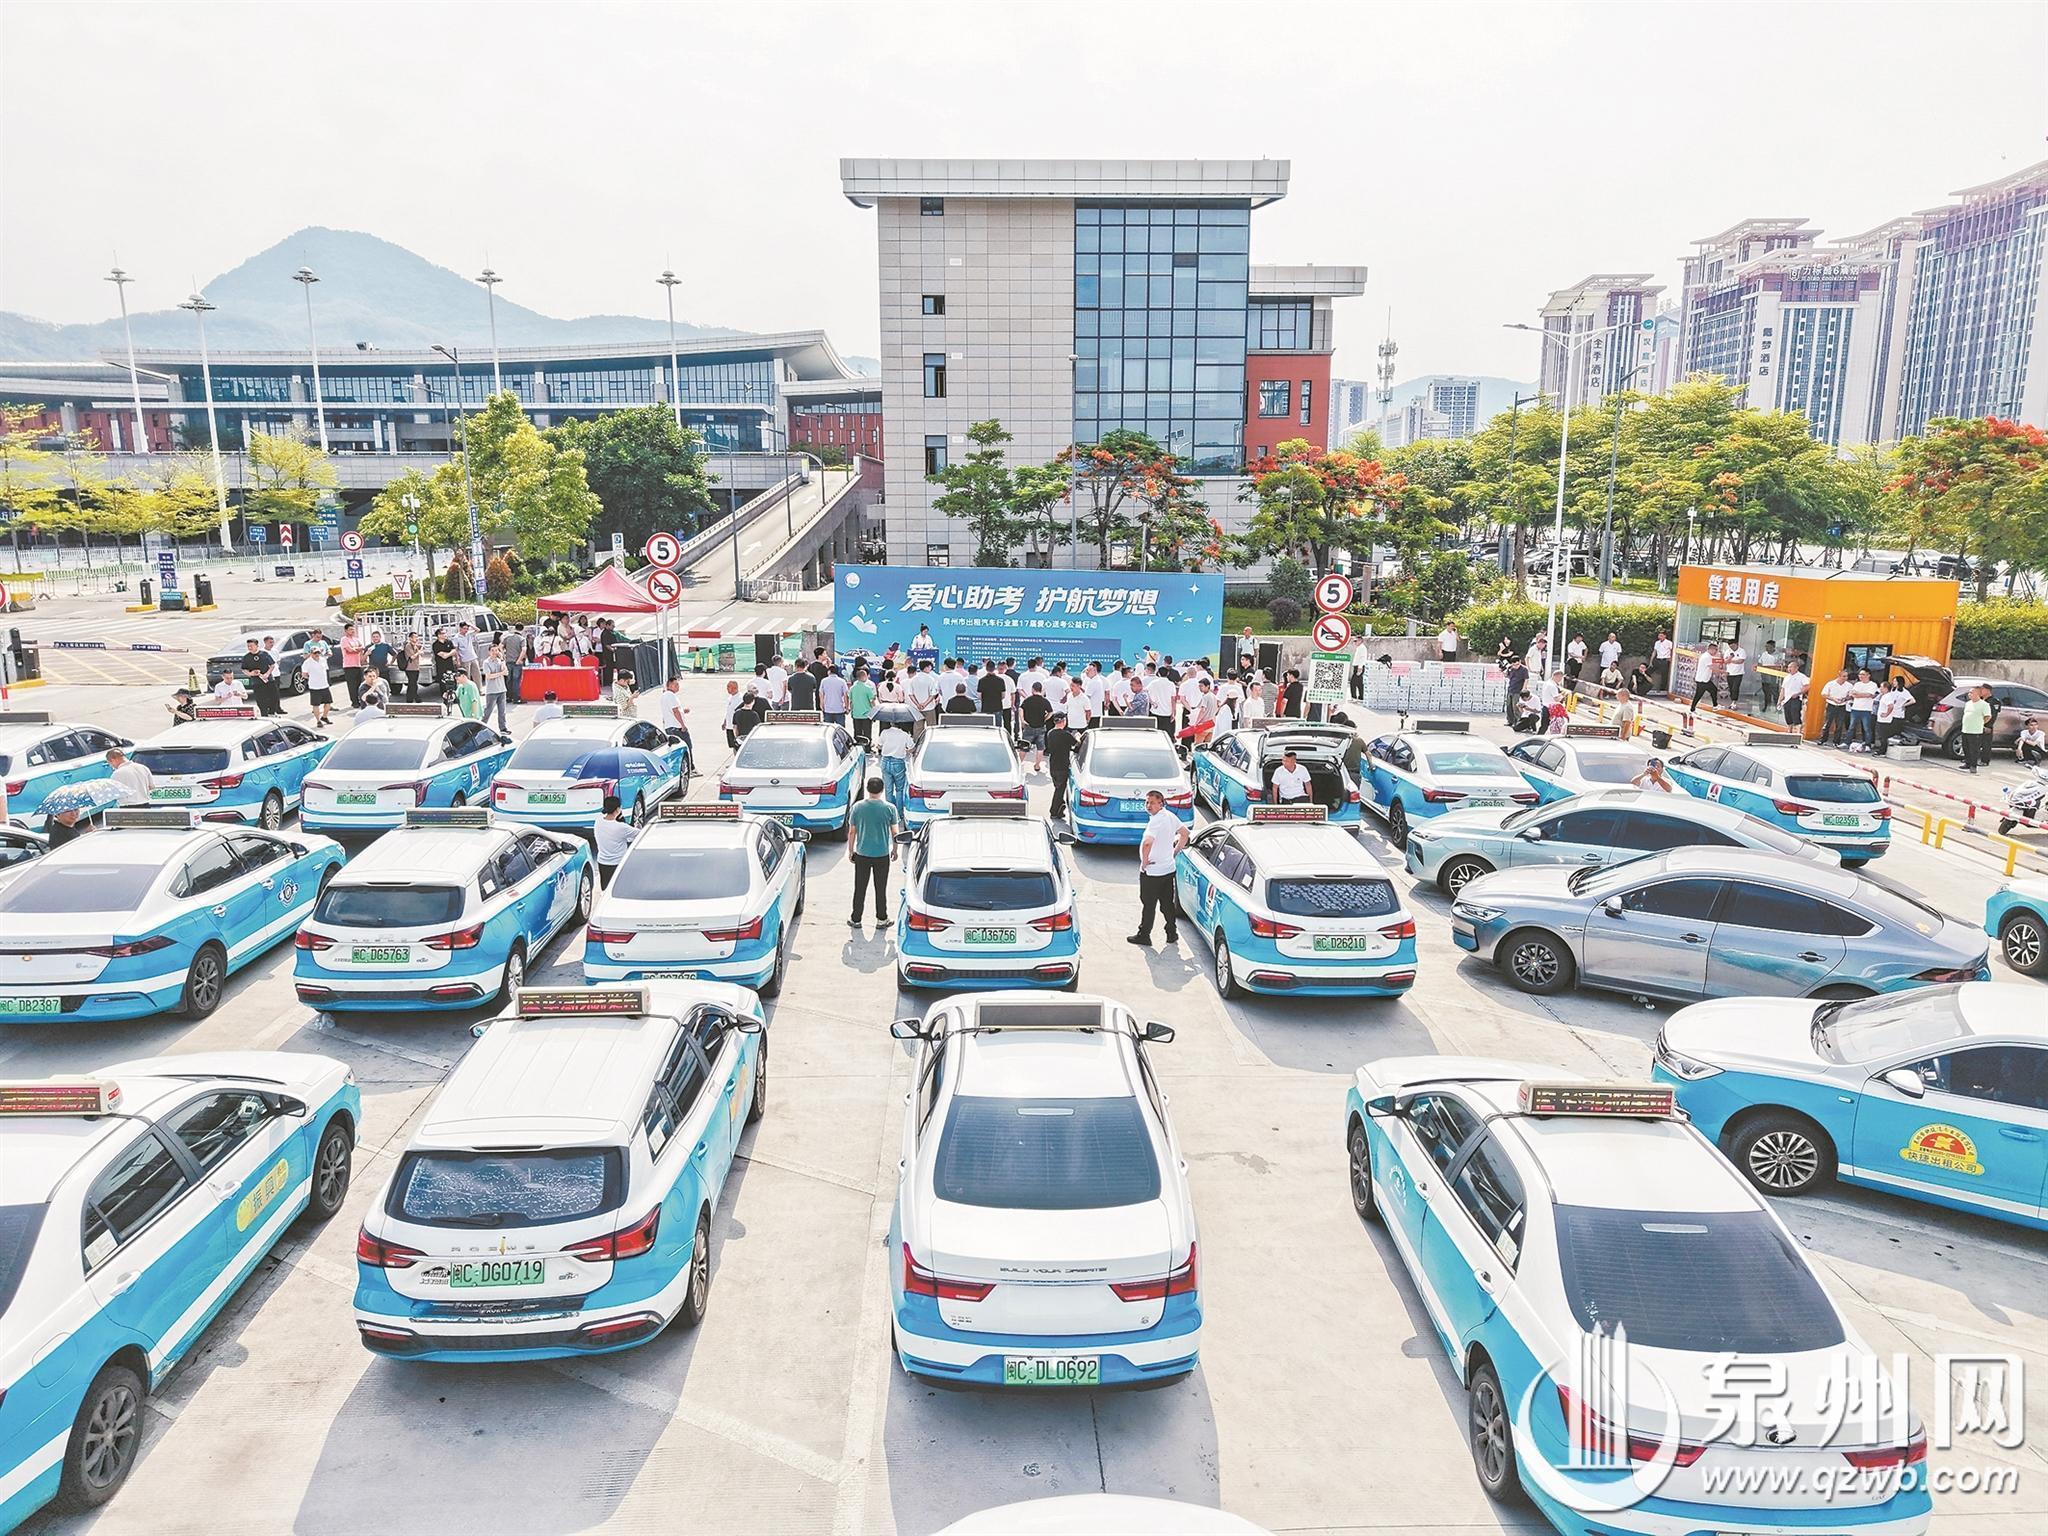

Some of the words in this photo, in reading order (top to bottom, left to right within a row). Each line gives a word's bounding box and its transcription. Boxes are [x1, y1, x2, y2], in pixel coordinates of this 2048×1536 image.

[1591, 338, 1604, 388] 全季酒店
[349, 536, 356, 546] 5
[657, 541, 670, 560] 5
[899, 583, 1026, 613] 爱心助考
[1035, 586, 1160, 617] 护航梦想
[1327, 583, 1341, 604] 5
[1708, 574, 1780, 609] 管理用房
[1907, 1151, 1977, 1173] 快捷出租公司
